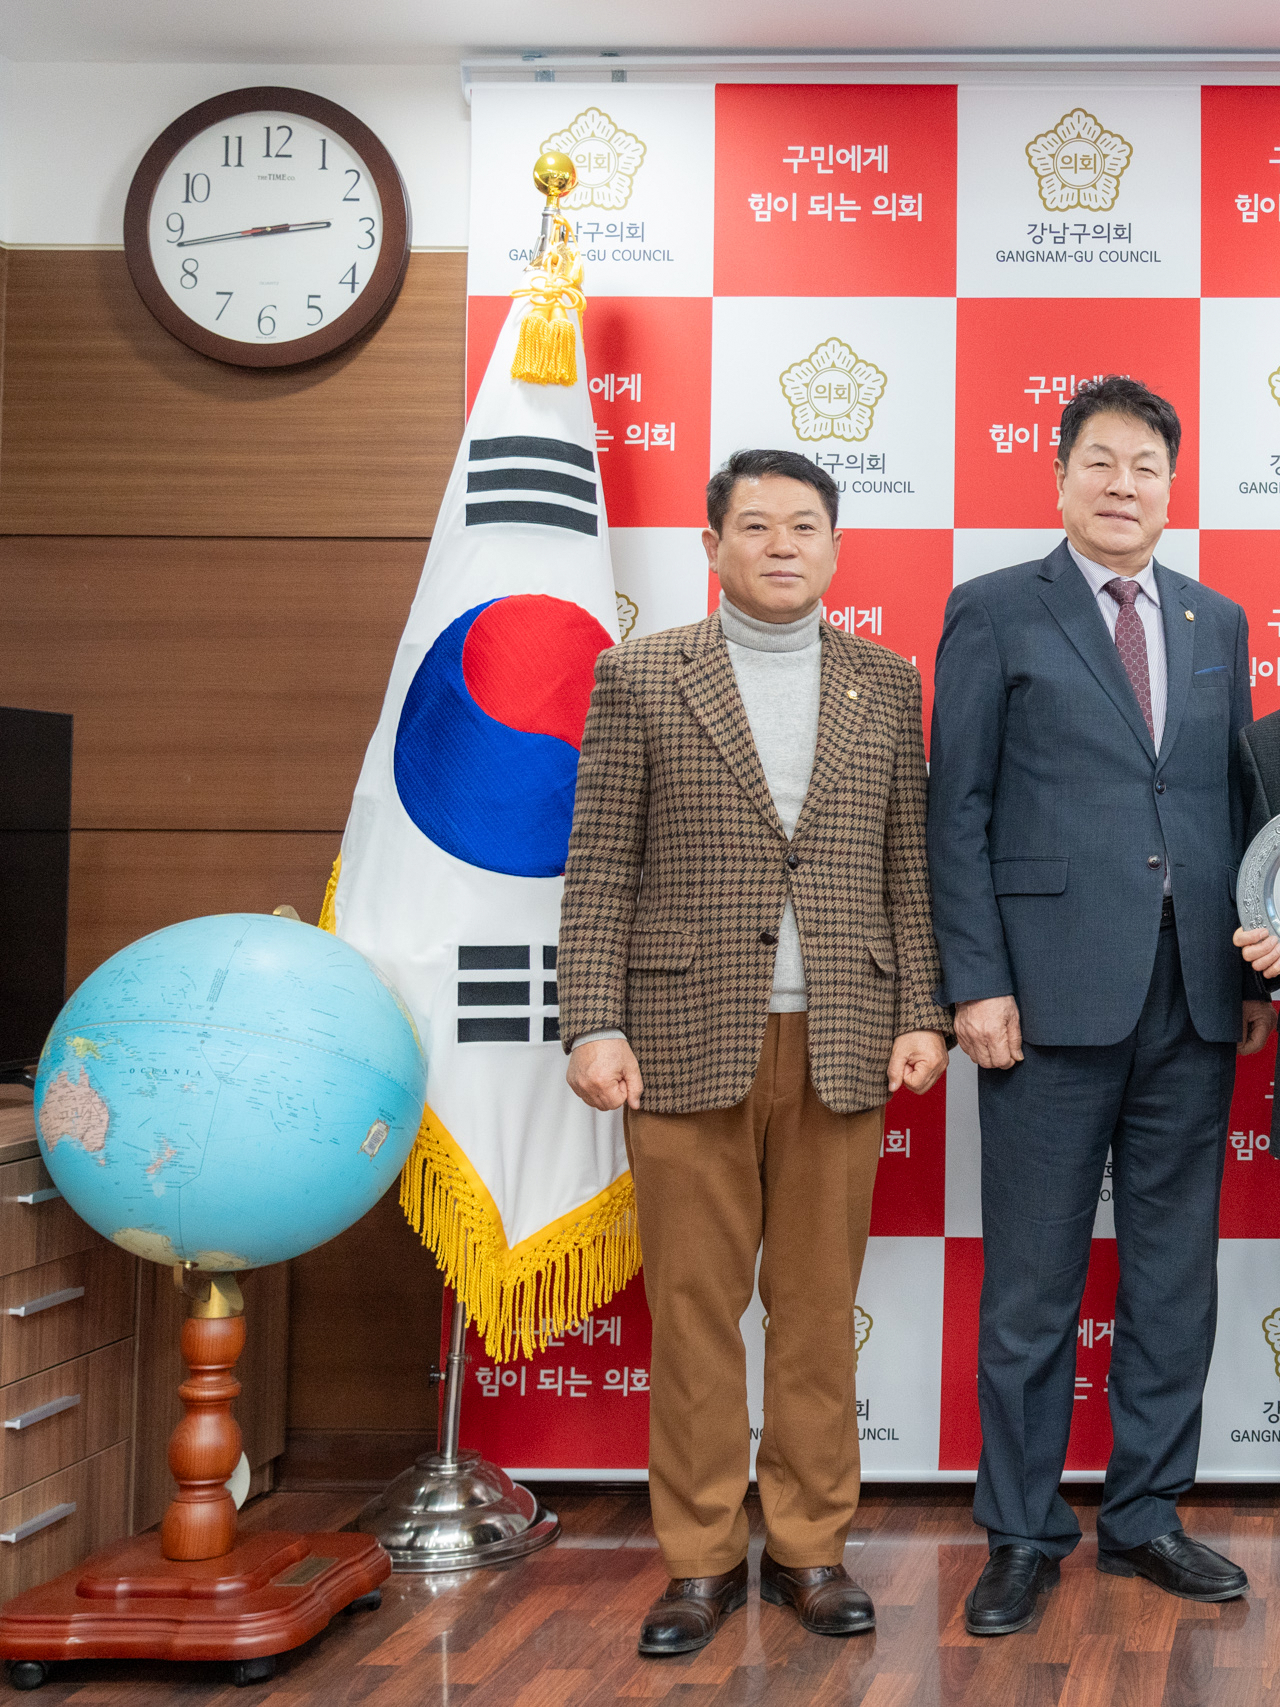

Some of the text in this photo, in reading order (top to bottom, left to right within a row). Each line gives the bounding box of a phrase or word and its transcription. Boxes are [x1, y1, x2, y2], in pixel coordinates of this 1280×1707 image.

[221, 136, 244, 167] 11
[262, 126, 292, 158] 12
[318, 139, 328, 170] 1
[576, 153, 610, 174] 의회
[783, 145, 889, 174] 구민에게
[1060, 152, 1097, 174] 의회
[182, 173, 210, 203] 10
[343, 170, 360, 201] 2
[749, 192, 923, 222] 힘이 되는 의회
[166, 213, 184, 243] 9
[358, 217, 375, 249] 3
[1027, 223, 1132, 243] 강남구의회
[612, 249, 674, 262] COUNCIL
[996, 250, 1161, 262] GANGNAM-GU COUNCIL
[180, 258, 198, 289] 8
[339, 262, 359, 293] 4
[216, 292, 233, 320] 7
[257, 305, 277, 336] 6
[307, 295, 323, 326] 5
[589, 374, 642, 402] 에게
[814, 383, 851, 404] 의회
[594, 422, 676, 452] 는 의회
[990, 423, 1038, 452] 힘이
[815, 453, 886, 474] 구의회
[852, 481, 914, 494] COUNCIL
[824, 606, 882, 635] 에게
[129, 1068, 201, 1076] OCEANIA
[880, 1129, 910, 1159] 회
[476, 1367, 526, 1396] 힘이
[537, 1367, 592, 1396] 되는
[858, 1428, 899, 1441] UNCIL
